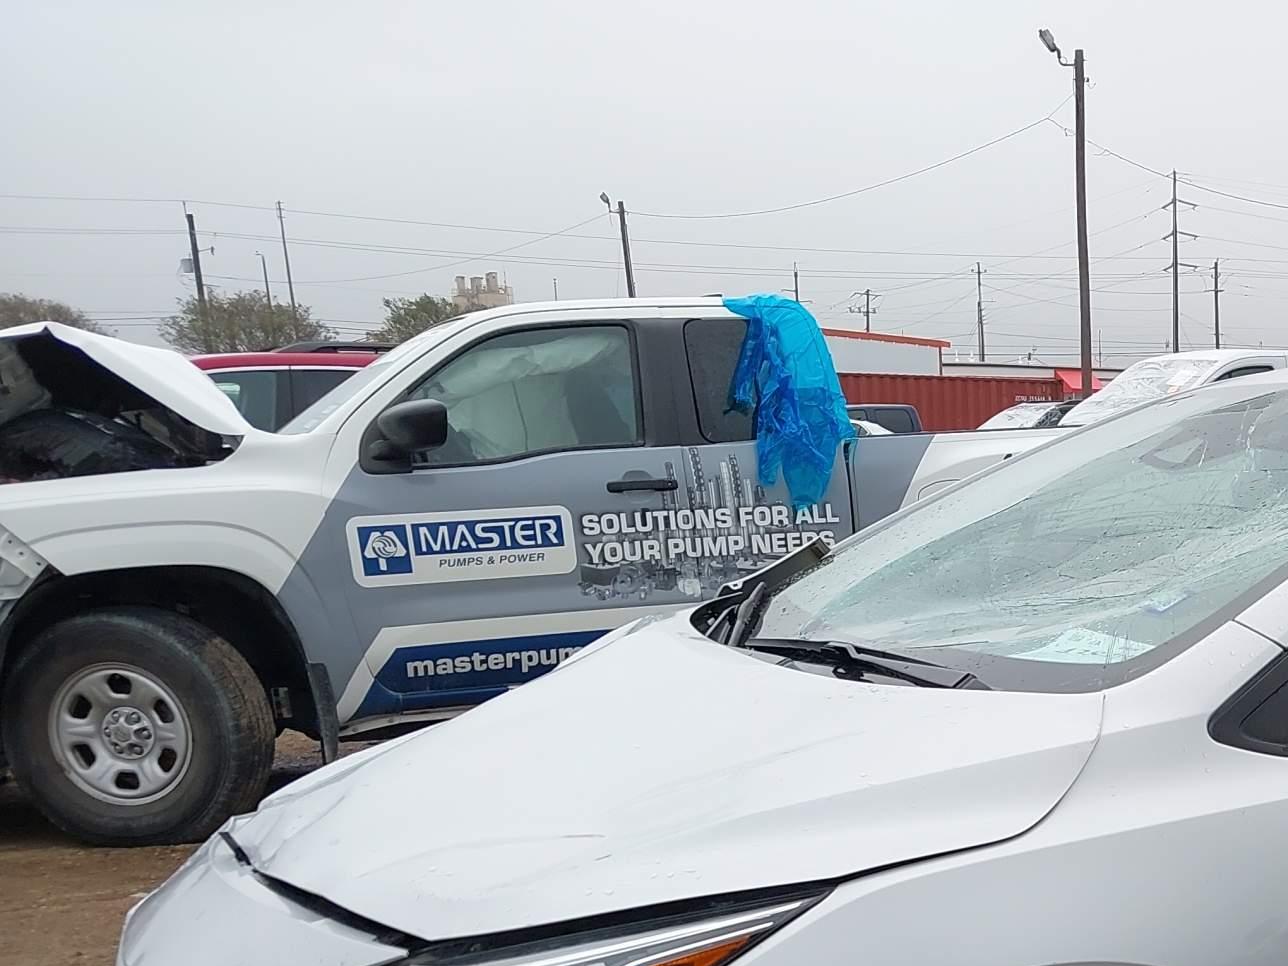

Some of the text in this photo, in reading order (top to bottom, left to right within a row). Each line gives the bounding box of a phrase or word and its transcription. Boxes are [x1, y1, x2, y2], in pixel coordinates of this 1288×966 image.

[582, 503, 840, 536] SOLUTIONS FOR ALL
[418, 519, 560, 552] MASTER
[584, 539, 662, 564] YOUR
[667, 535, 745, 559] PUMP
[439, 553, 545, 568] PUMPS & POWER
